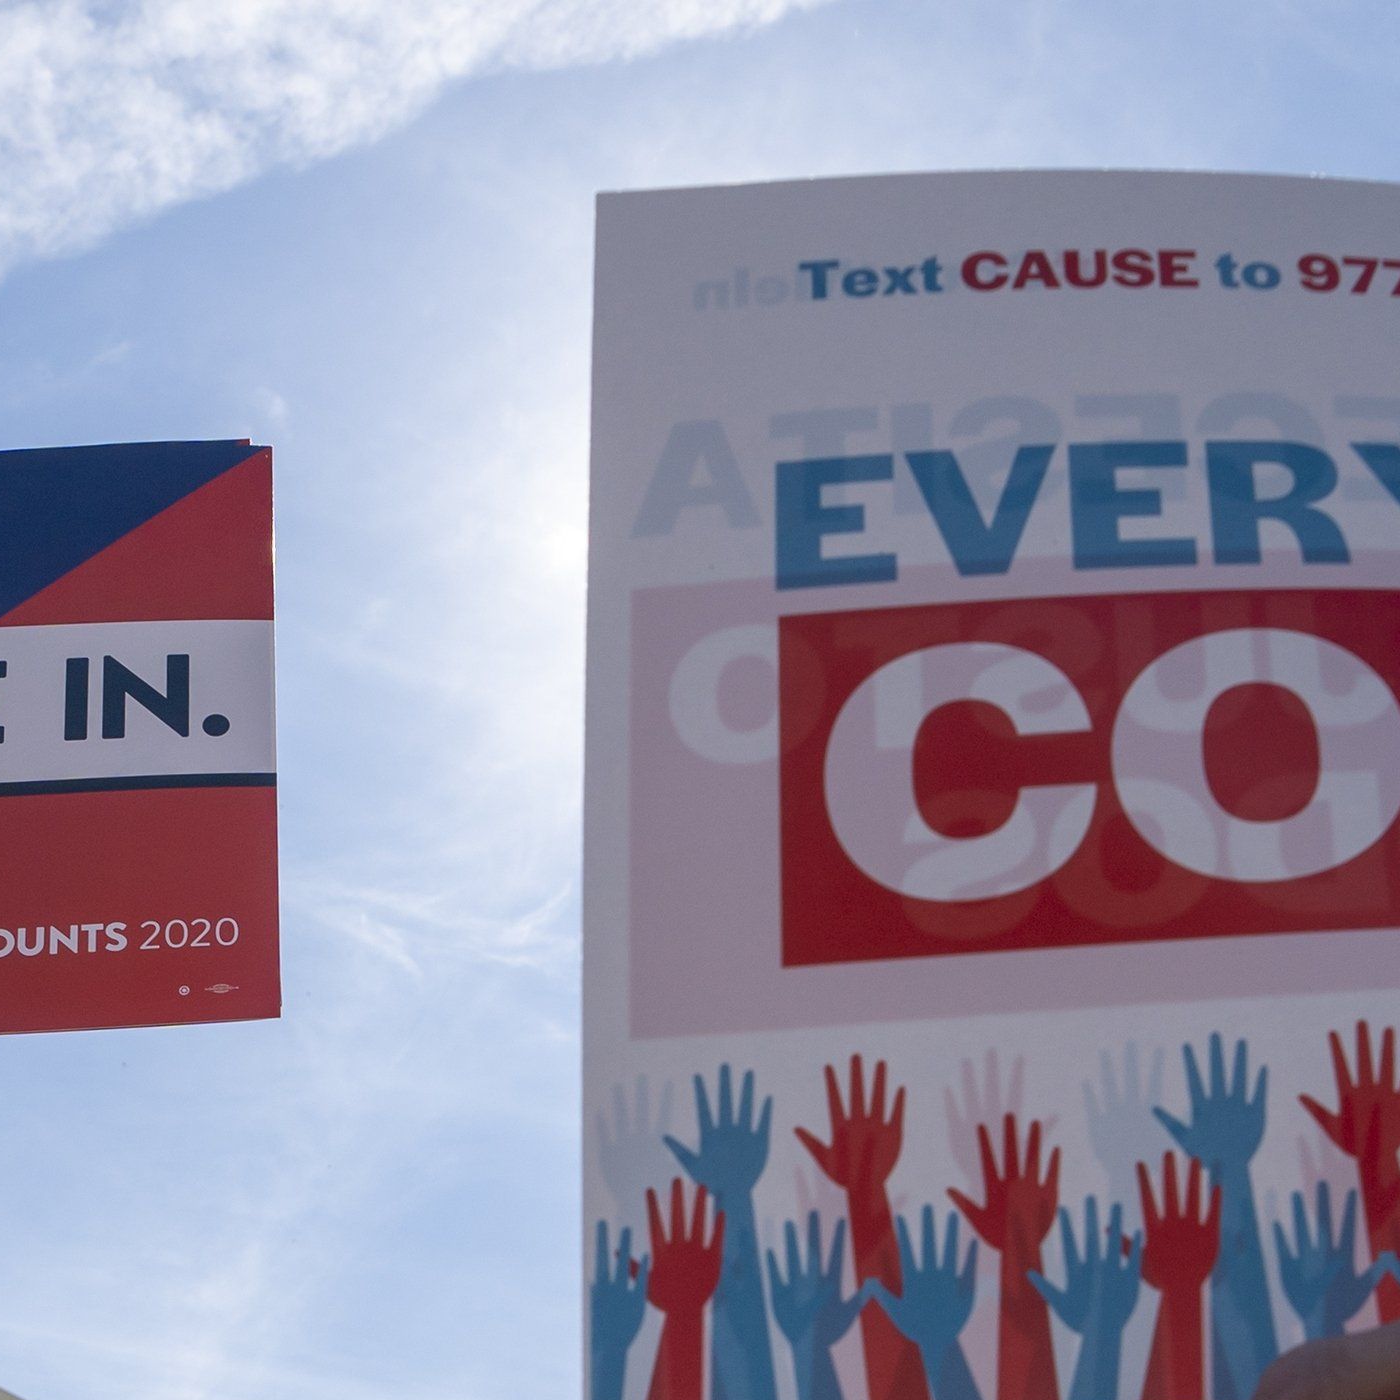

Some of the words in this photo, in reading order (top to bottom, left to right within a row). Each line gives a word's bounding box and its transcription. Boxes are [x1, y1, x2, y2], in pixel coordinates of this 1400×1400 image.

[798, 257, 945, 302] Text
[959, 247, 1200, 292] CAUSE
[1213, 252, 1282, 291] to
[62, 653, 232, 742] IN.
[139, 916, 240, 951] 2020
